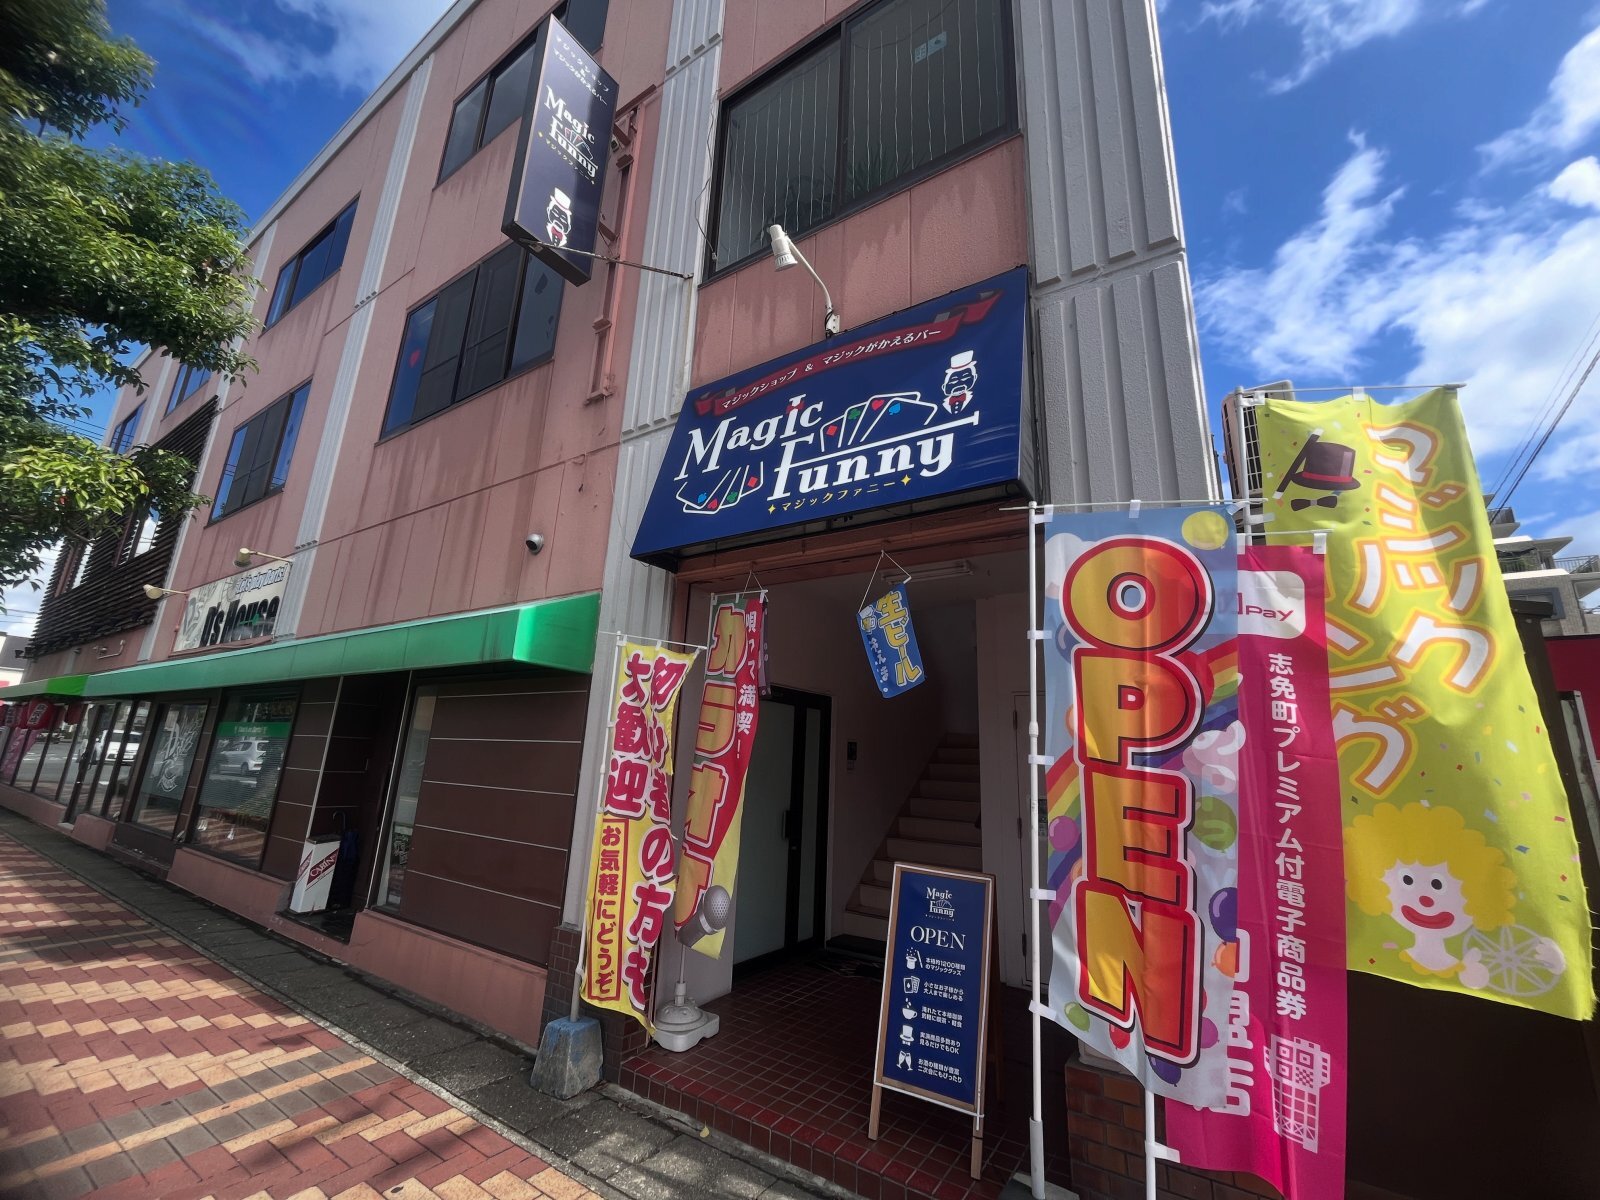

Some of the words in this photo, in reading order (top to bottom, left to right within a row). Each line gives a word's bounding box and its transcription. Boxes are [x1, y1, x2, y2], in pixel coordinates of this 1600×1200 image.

[544, 85, 595, 145] Magic
[548, 115, 599, 178] Funny
[720, 367, 798, 409] マジックショップ
[804, 363, 814, 373] &
[821, 327, 942, 366] マジックがかえるバー
[673, 393, 824, 481] Magic
[767, 411, 972, 502] Funny
[782, 482, 896, 512] マジックファニー
[1364, 422, 1492, 696] マジック
[876, 590, 922, 687] 生ビール
[604, 652, 653, 818] 大歓迎
[1062, 537, 1214, 1070] OPEN
[1268, 653, 1306, 1021] 志免町プレミアム付電子商品券
[595, 825, 622, 994] お気軽にどうぞ
[926, 886, 952, 900] Magic
[929, 900, 955, 918] Funny
[910, 925, 966, 951] OPEN
